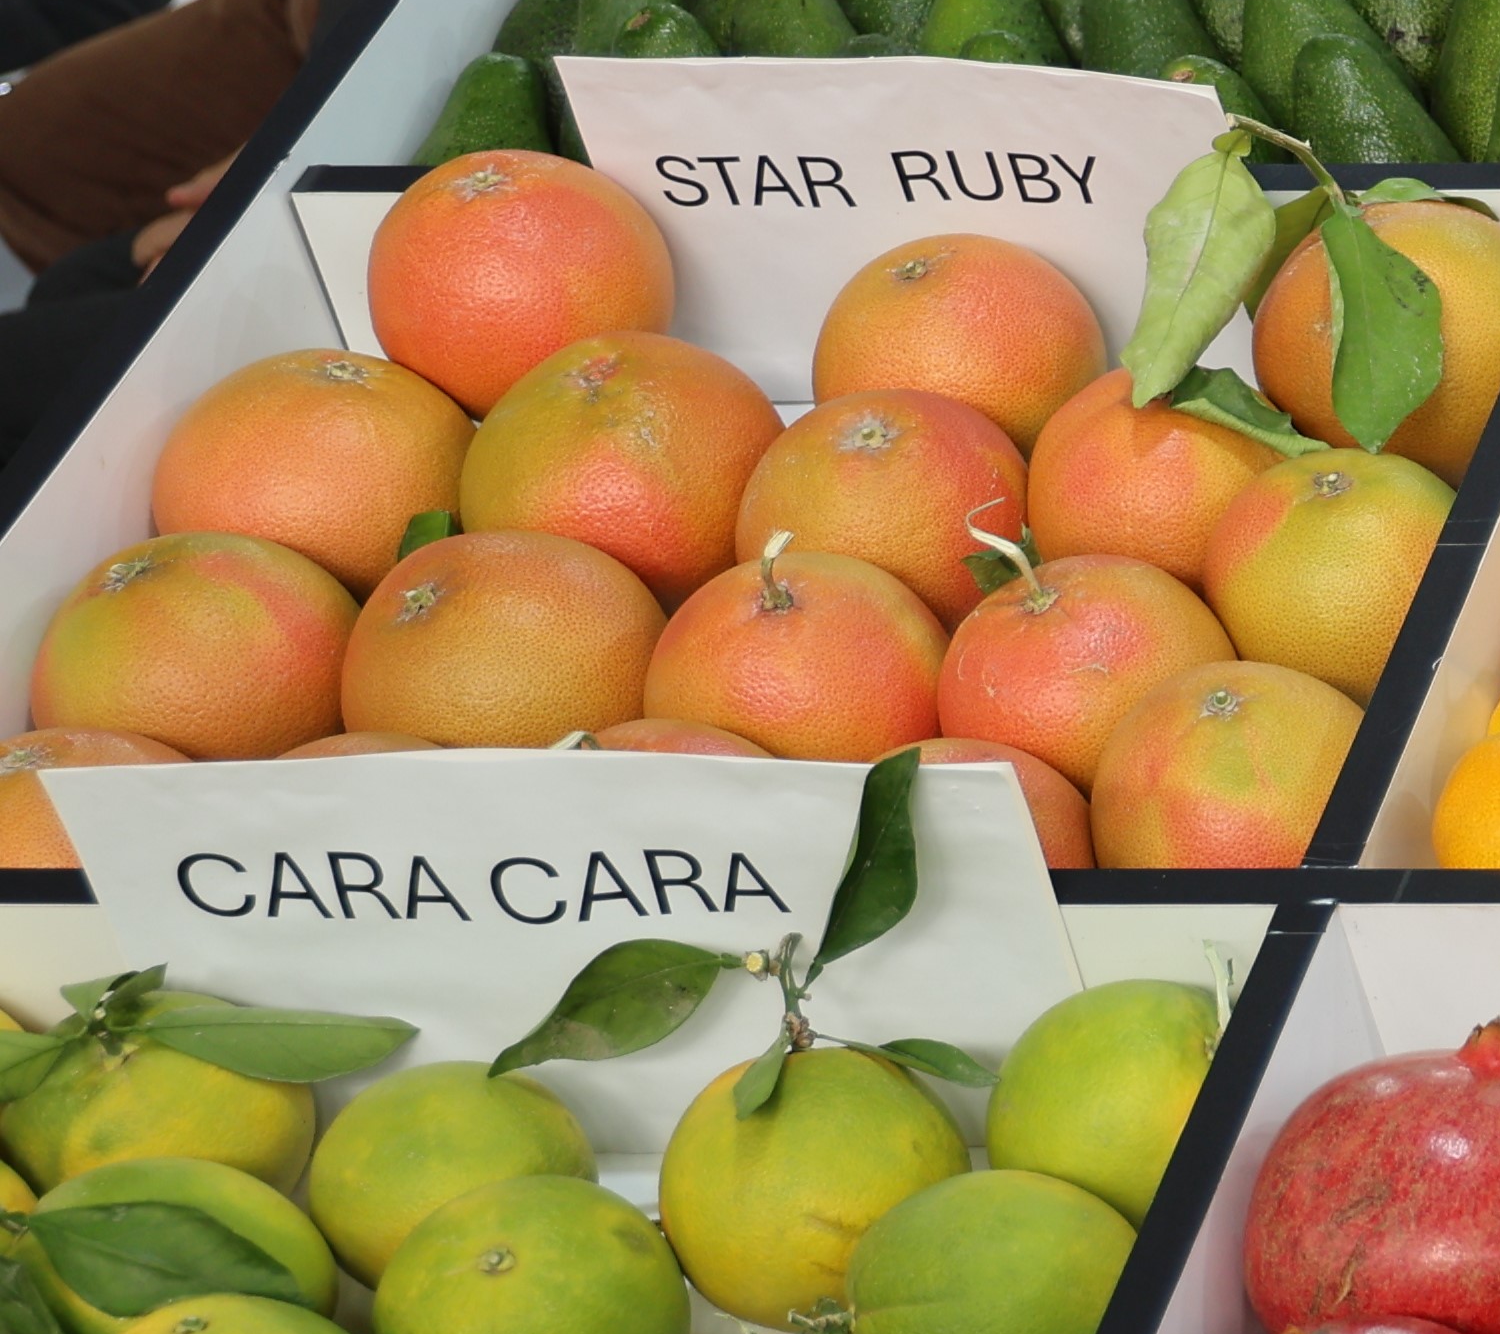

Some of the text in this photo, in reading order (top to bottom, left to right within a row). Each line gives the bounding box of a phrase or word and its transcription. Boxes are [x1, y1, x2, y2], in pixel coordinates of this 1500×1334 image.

[655, 149, 1097, 208] STAR RUBY
[176, 848, 791, 925] CARA CARA
